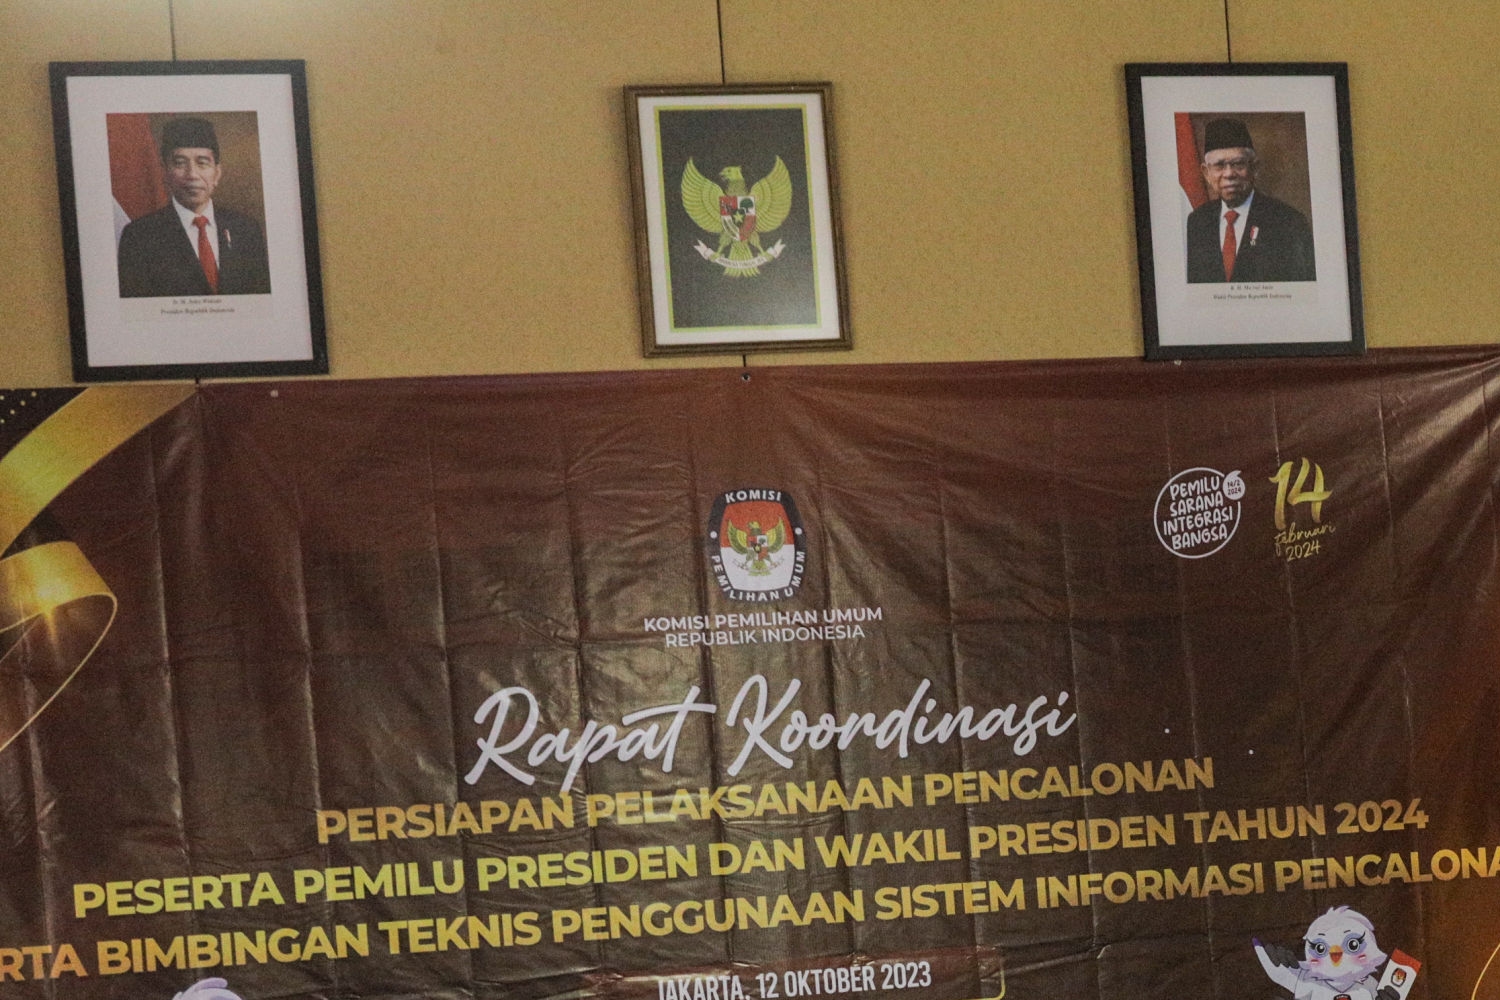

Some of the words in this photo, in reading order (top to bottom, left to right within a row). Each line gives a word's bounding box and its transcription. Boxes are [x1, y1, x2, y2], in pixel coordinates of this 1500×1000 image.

[725, 489, 782, 503] KOMISI
[1169, 475, 1220, 500] PEMILU
[1268, 457, 1333, 530] 14
[1169, 491, 1224, 517] SARANA
[1163, 506, 1233, 535] INTEGRASI
[1171, 523, 1228, 550] BANGSA
[1286, 540, 1321, 562] 2024
[711, 555, 779, 601] PEMILIHAN
[785, 551, 806, 597] UMUM
[644, 615, 710, 632] KOMISI
[715, 609, 817, 629] PEMILIHAN
[823, 607, 882, 623] UMUM
[665, 629, 757, 647] REPUBLIK
[763, 624, 865, 643] INDONESIA
[464, 685, 716, 793] Rapat
[726, 673, 1077, 777] Koordinasi
[316, 797, 574, 844] PERSIAPAN
[585, 774, 913, 827] PELAKSANAAN
[925, 756, 1215, 805] PENCALONAN
[72, 871, 285, 919] PESERTA
[293, 859, 465, 903] PEMILU
[477, 844, 698, 892] PRESIDEN
[709, 837, 805, 877] DAN
[814, 829, 961, 869] WAKIL
[970, 813, 1176, 859] PRESIDEN
[1183, 803, 1326, 845] TAHUN
[1333, 797, 1430, 835] 2024
[96, 923, 370, 976] BIMBINGAN
[378, 912, 542, 956] TEKNIS
[552, 891, 864, 943] PENGGUNAAN
[875, 878, 1027, 921] SISTEM
[1036, 862, 1265, 909] INFORMASI
[755, 971, 779, 999] 12
[784, 965, 877, 998] OKTOBER
[880, 961, 932, 990] 2023
